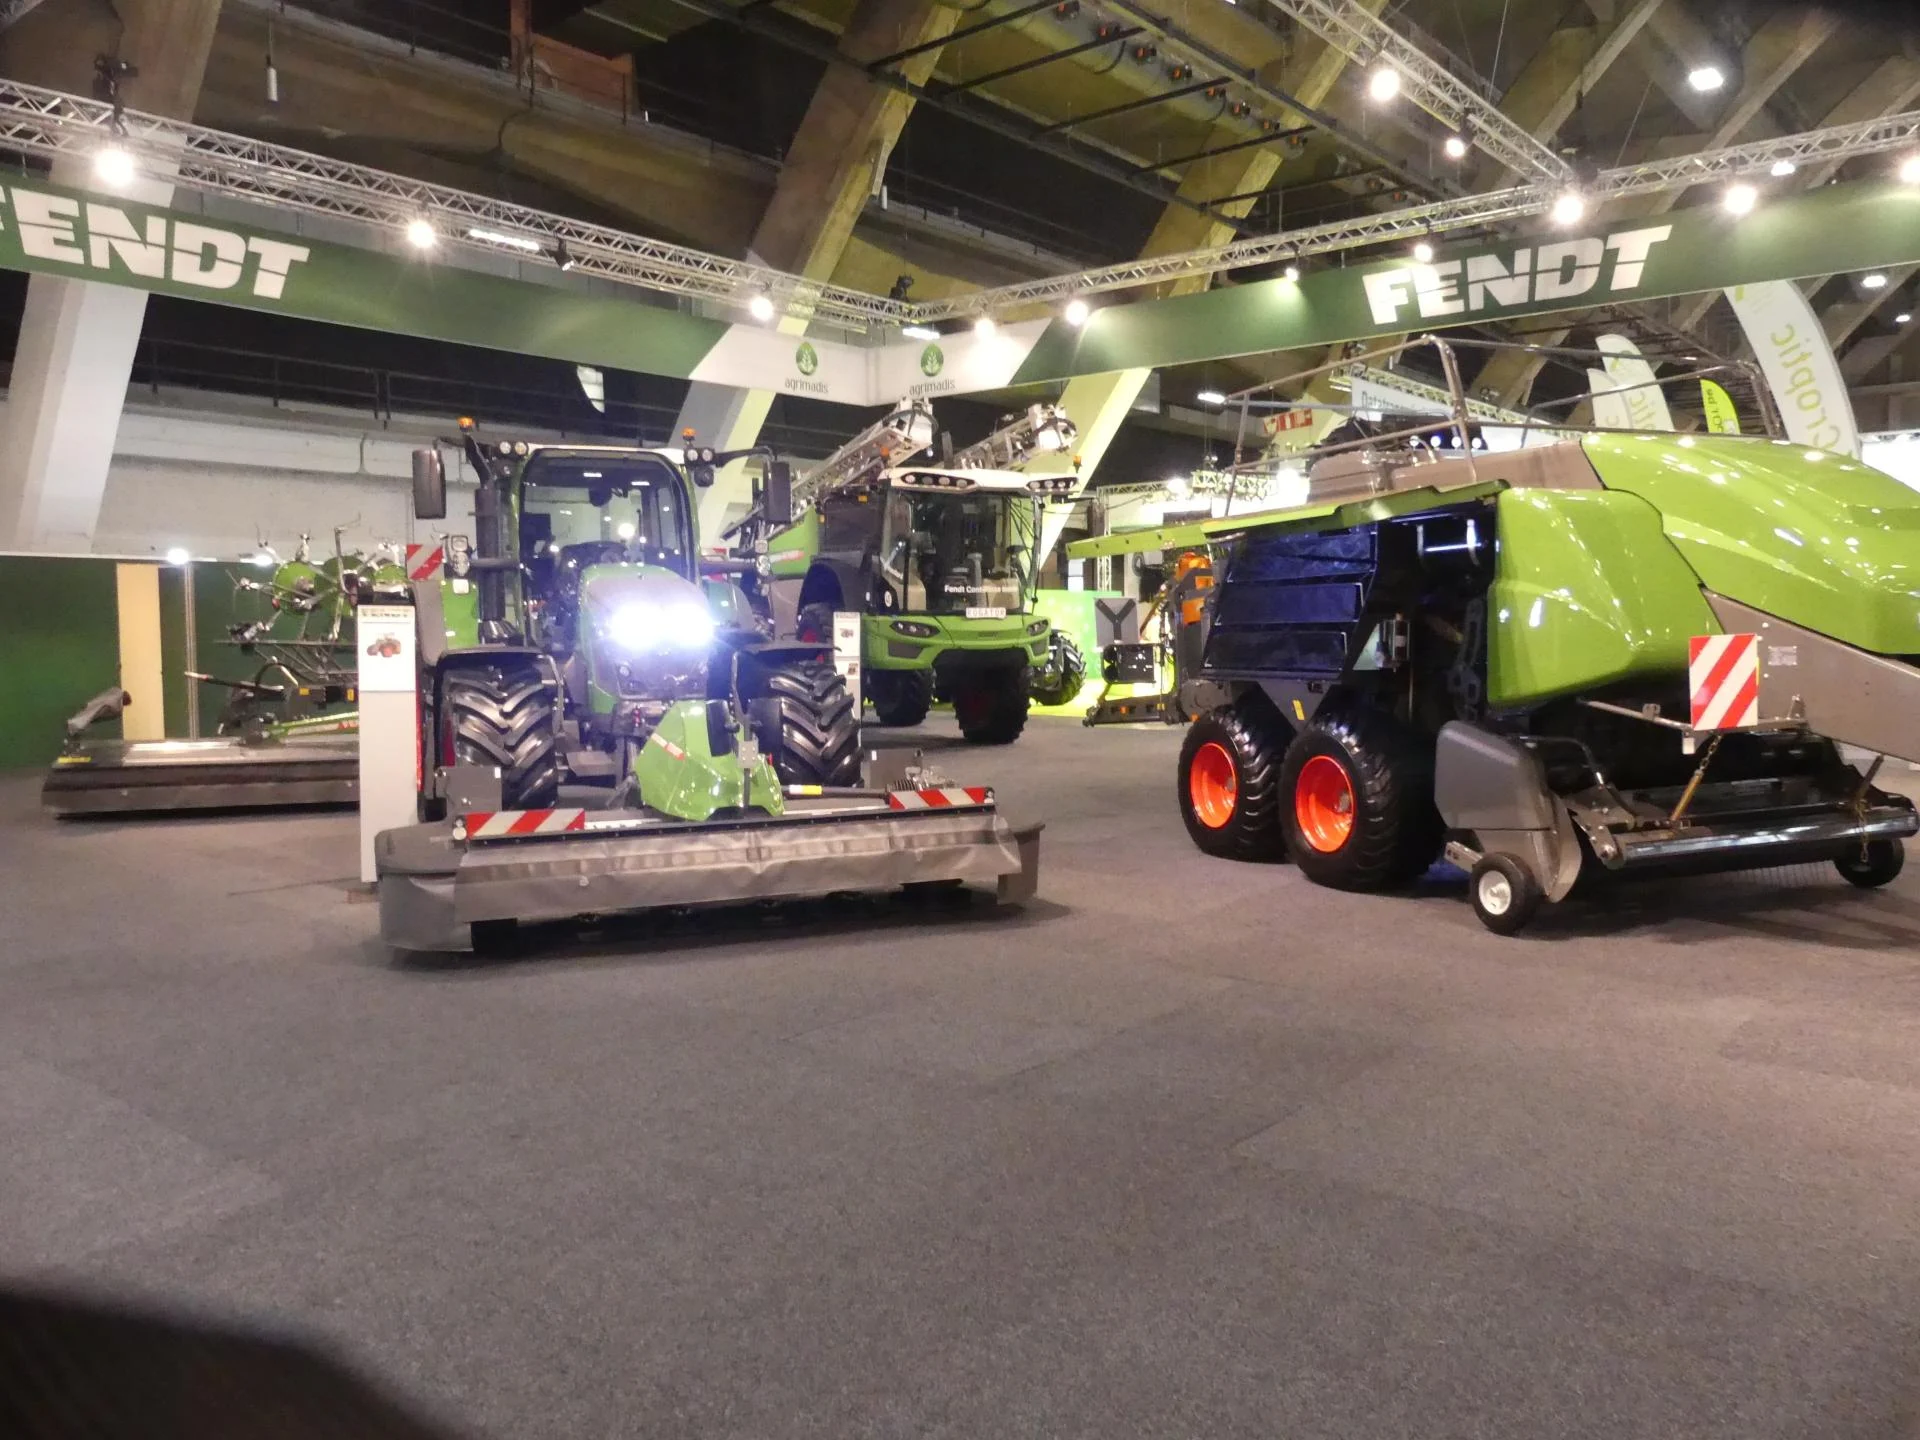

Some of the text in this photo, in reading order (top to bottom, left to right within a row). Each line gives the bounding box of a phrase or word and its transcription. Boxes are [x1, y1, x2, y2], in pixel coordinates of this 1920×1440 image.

[0, 184, 310, 299] ENDT
[1362, 224, 1673, 325] FENDT
[784, 377, 829, 394] agrimadis
[908, 378, 956, 396] agrimadis
[944, 584, 965, 593] Fendt
